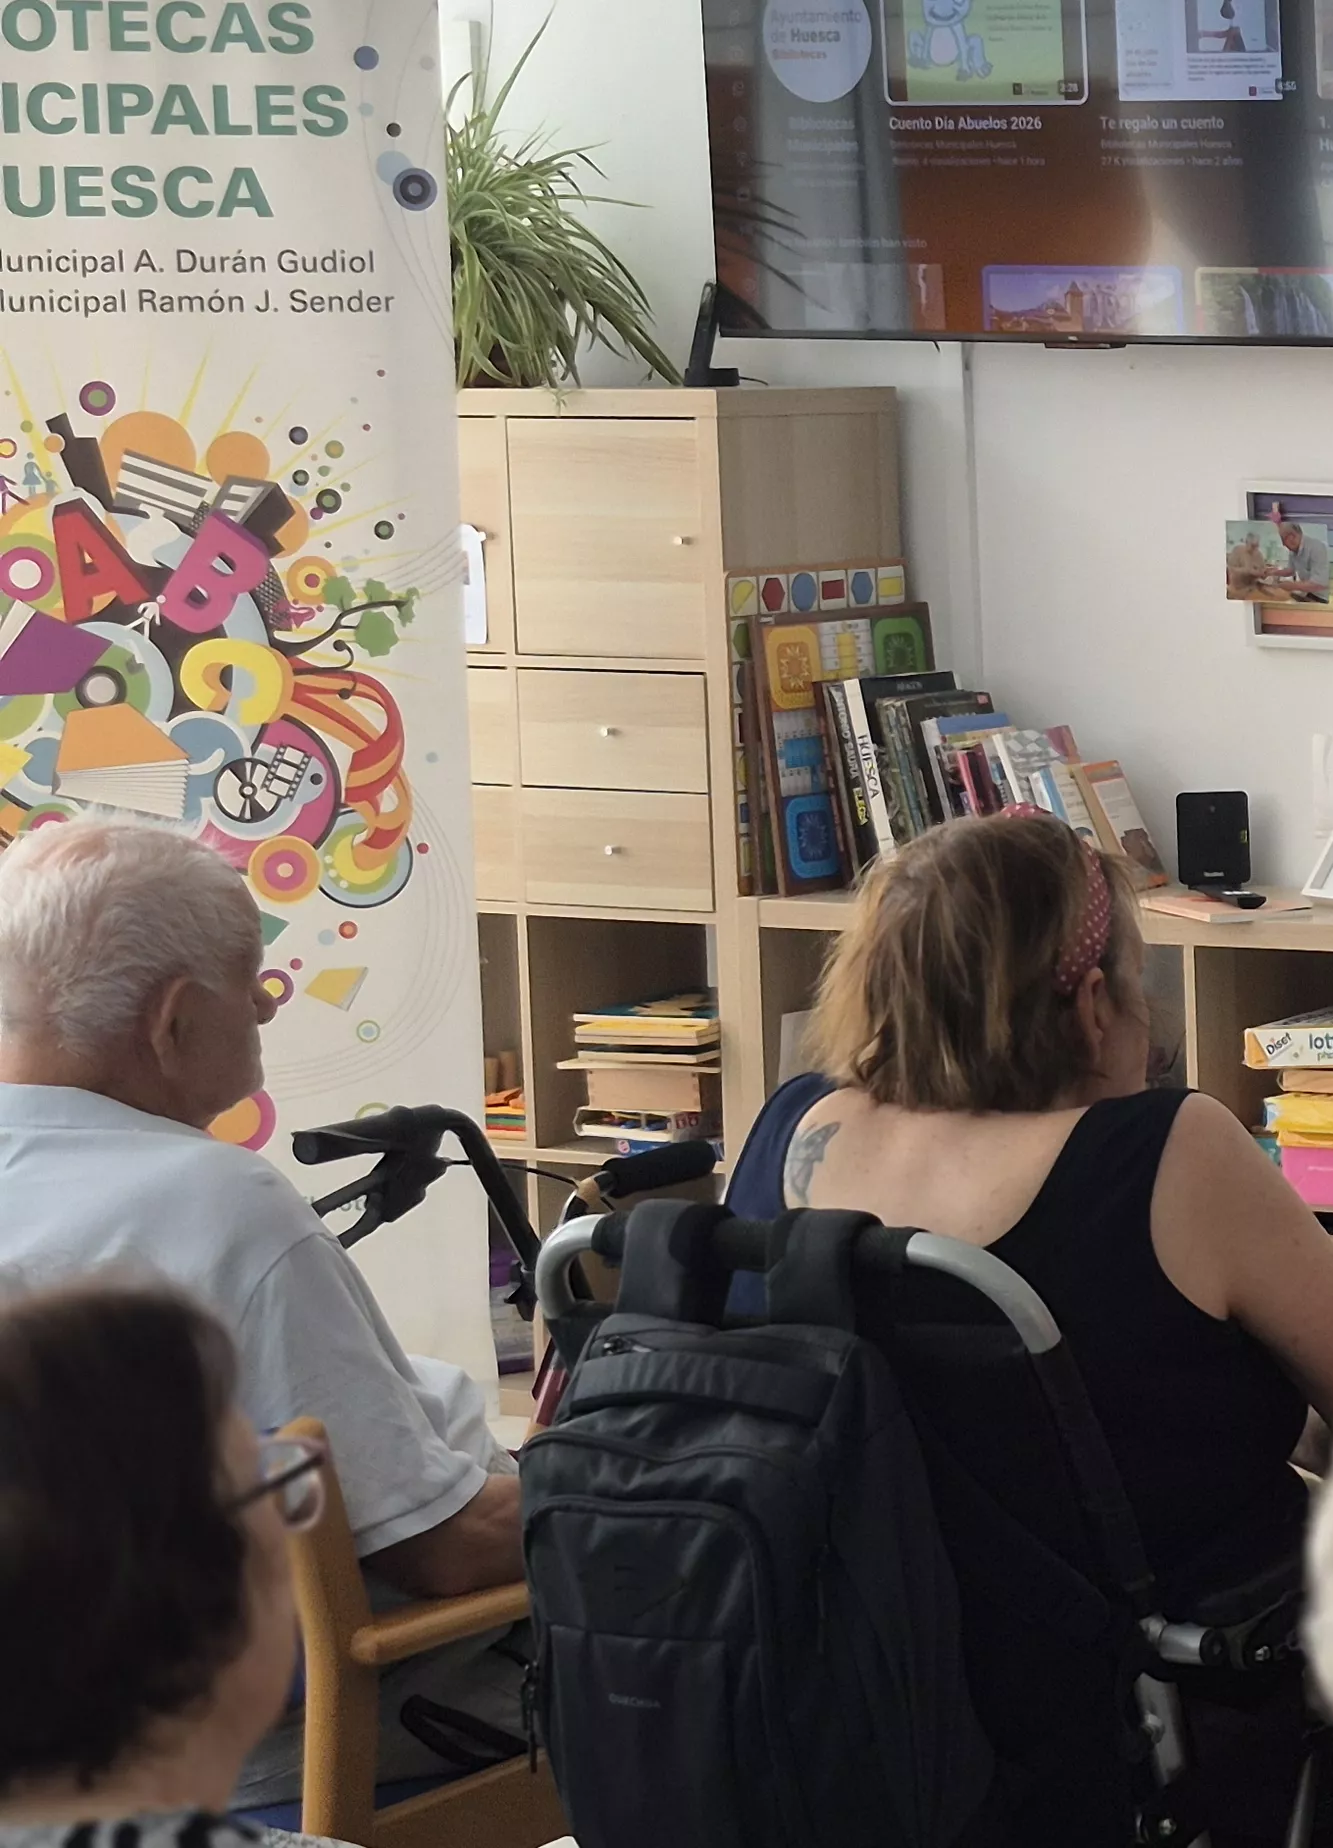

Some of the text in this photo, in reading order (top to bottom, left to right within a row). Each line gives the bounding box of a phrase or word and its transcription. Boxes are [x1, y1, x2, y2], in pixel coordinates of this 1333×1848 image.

[771, 10, 862, 26] Ayuntamiento
[790, 29, 841, 43] Huesca
[1, 81, 349, 137] ICIPALES
[889, 116, 1042, 131] Cuento Día Abuelos 2026
[1099, 115, 1225, 133] Te regalo un cuento
[1319, 115, 1331, 130] 1.
[1, 165, 275, 218] UESCA
[0, 248, 375, 279] unicipal A. Durán Gudiol
[138, 288, 245, 313] Ramón
[255, 288, 279, 313] J.
[289, 288, 395, 313] Sender
[857, 734, 879, 799] HUESCA
[1265, 1032, 1293, 1056] Diset
